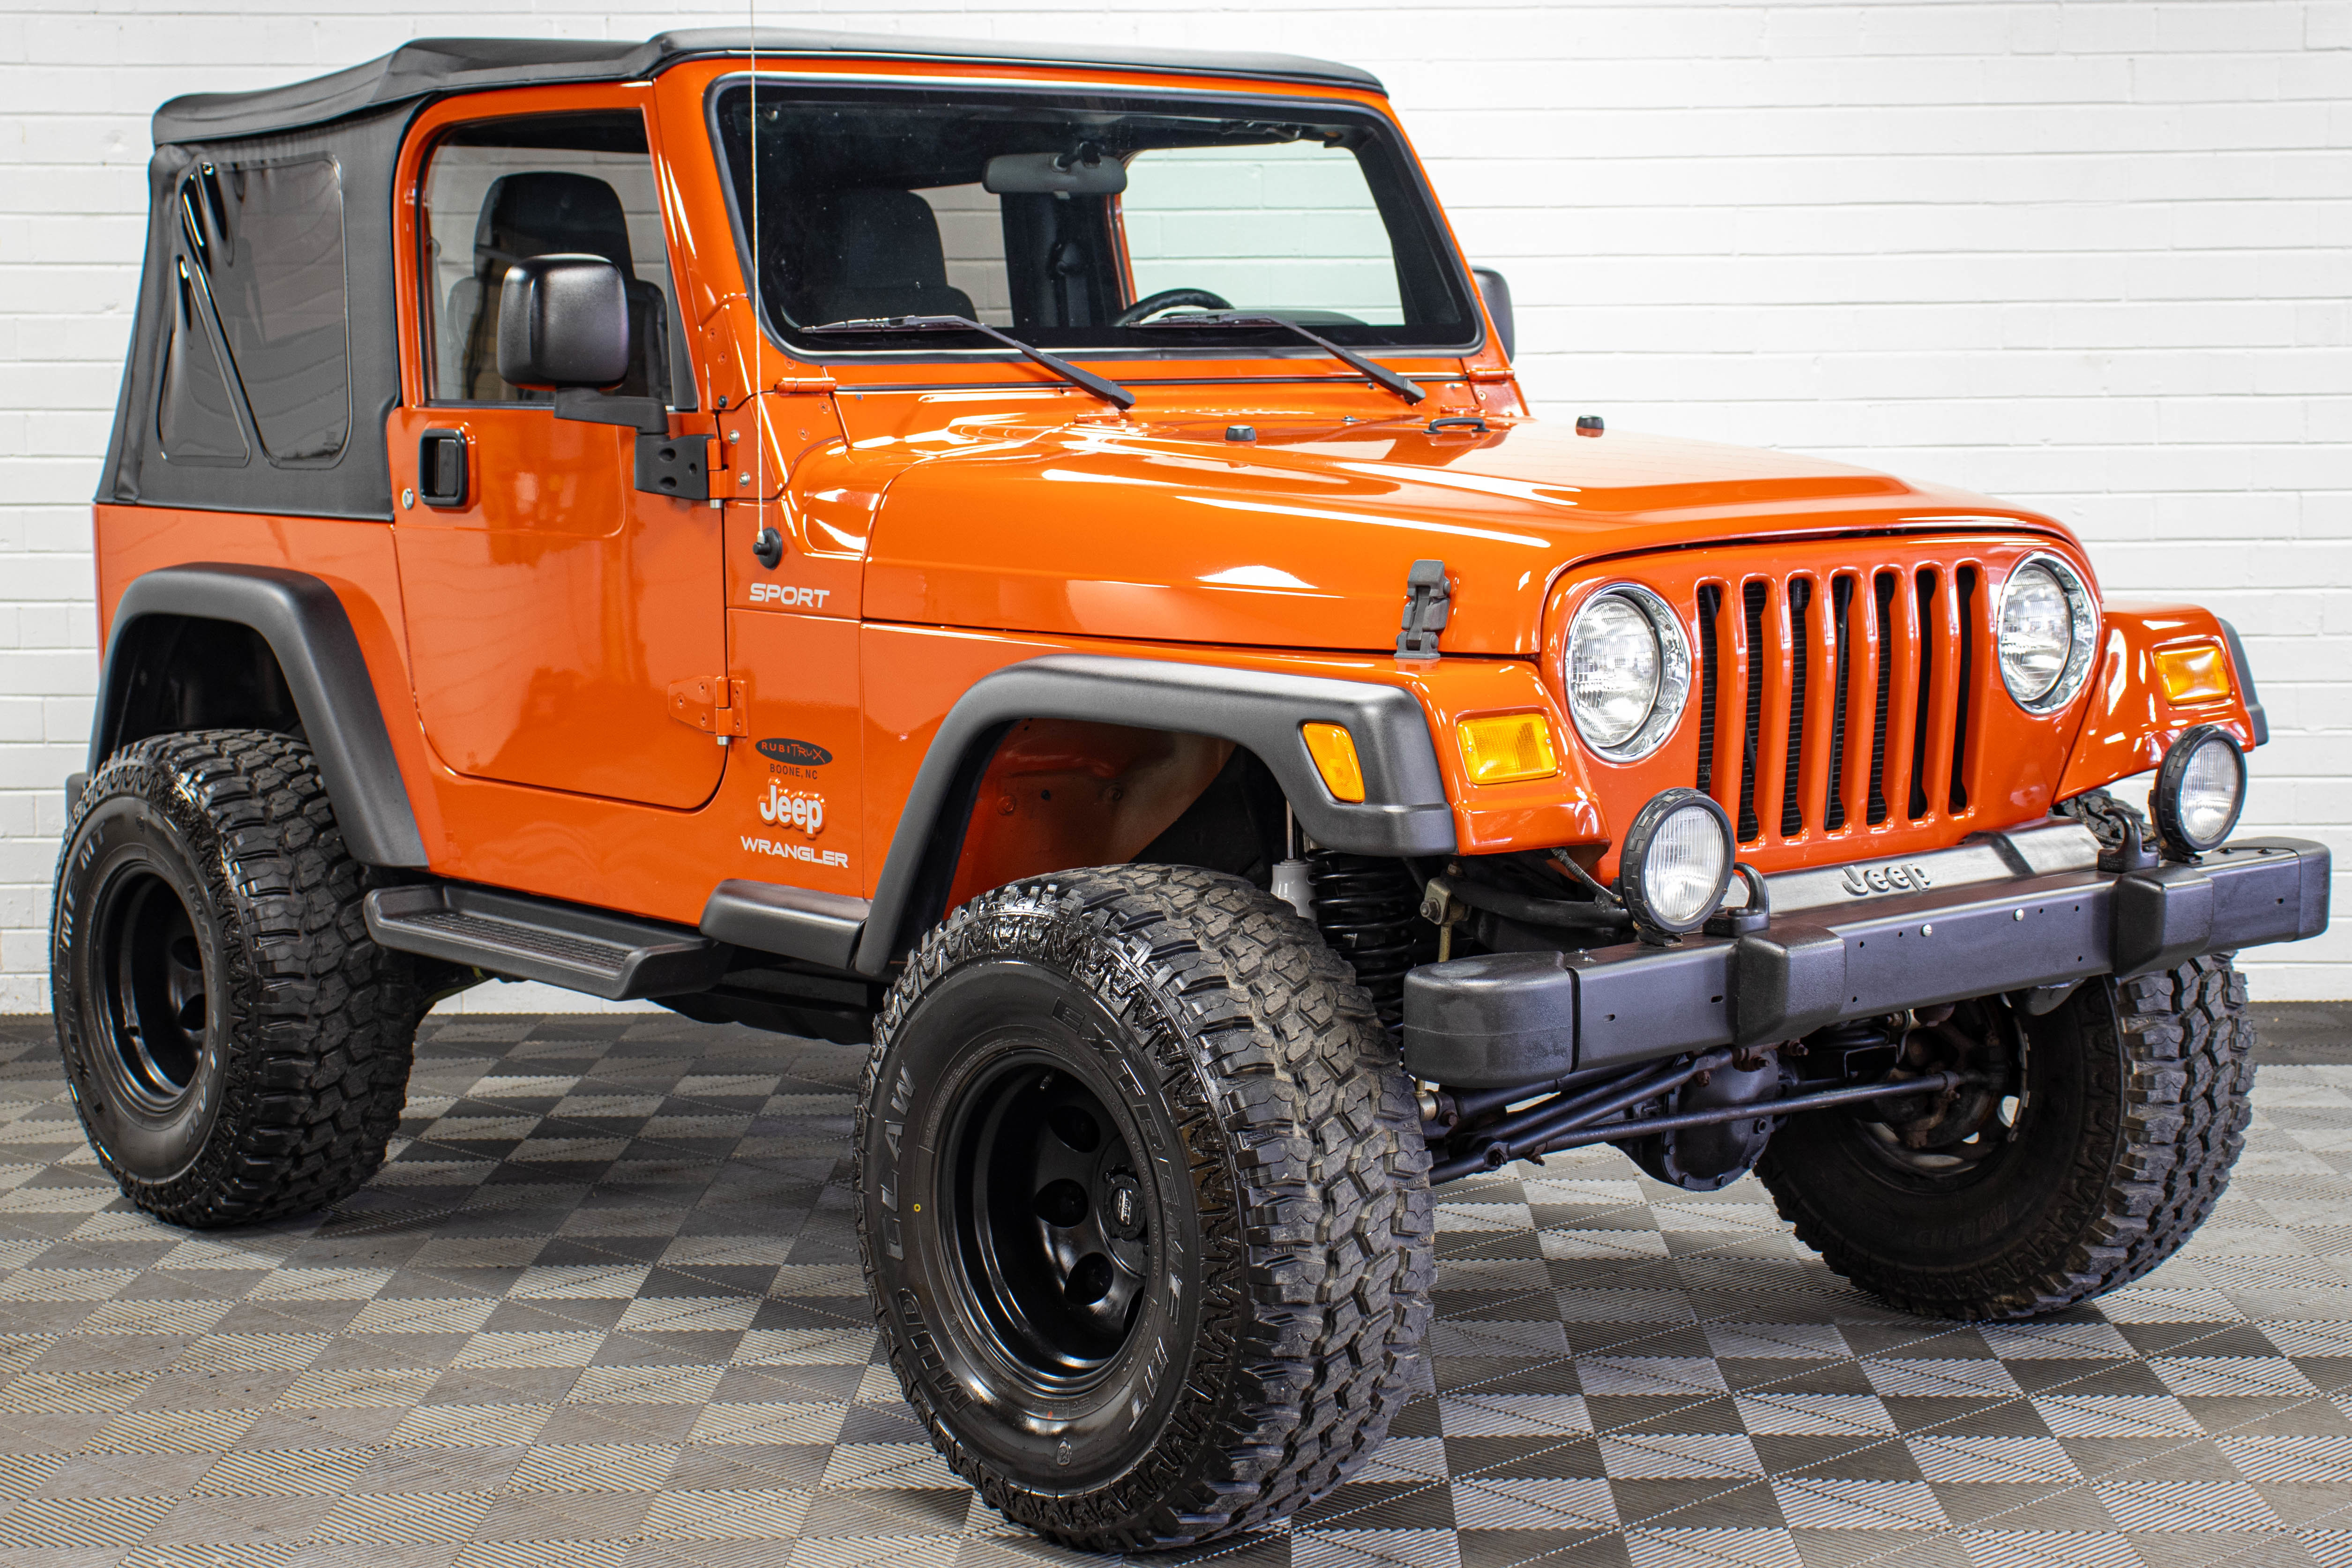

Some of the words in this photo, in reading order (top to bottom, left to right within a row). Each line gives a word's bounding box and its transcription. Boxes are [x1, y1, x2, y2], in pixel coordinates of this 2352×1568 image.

[749, 582, 830, 608] SPORT
[770, 764, 803, 779] BOONE,
[806, 769, 818, 779] NC
[760, 784, 824, 834] Jeep
[740, 836, 849, 868] WRANGLER
[1842, 863, 1931, 896] Jeep
[897, 1288, 975, 1414] MUD
